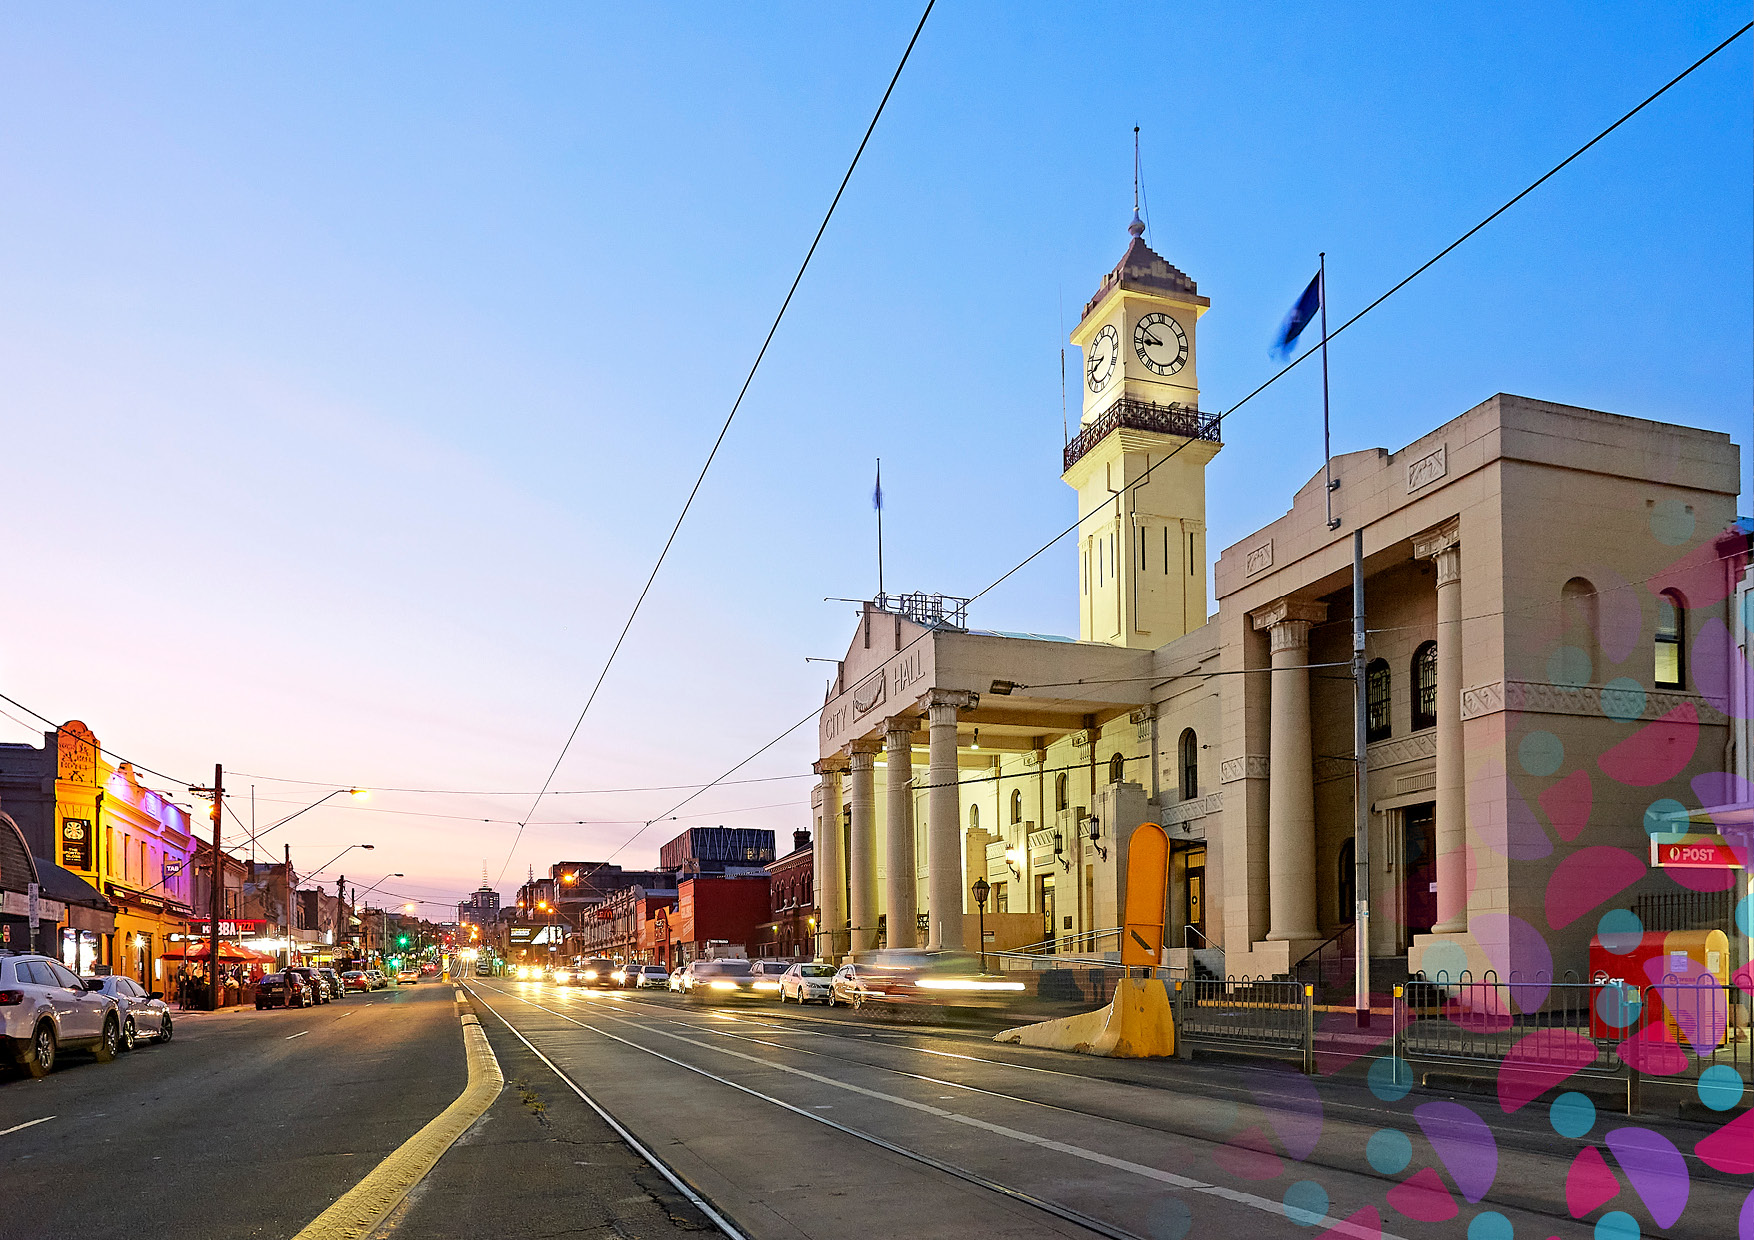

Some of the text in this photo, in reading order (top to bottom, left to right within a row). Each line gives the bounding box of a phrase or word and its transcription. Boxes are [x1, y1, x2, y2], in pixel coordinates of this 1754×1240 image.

[826, 650, 926, 740] CITY HALL
[1682, 848, 1715, 861] POST
